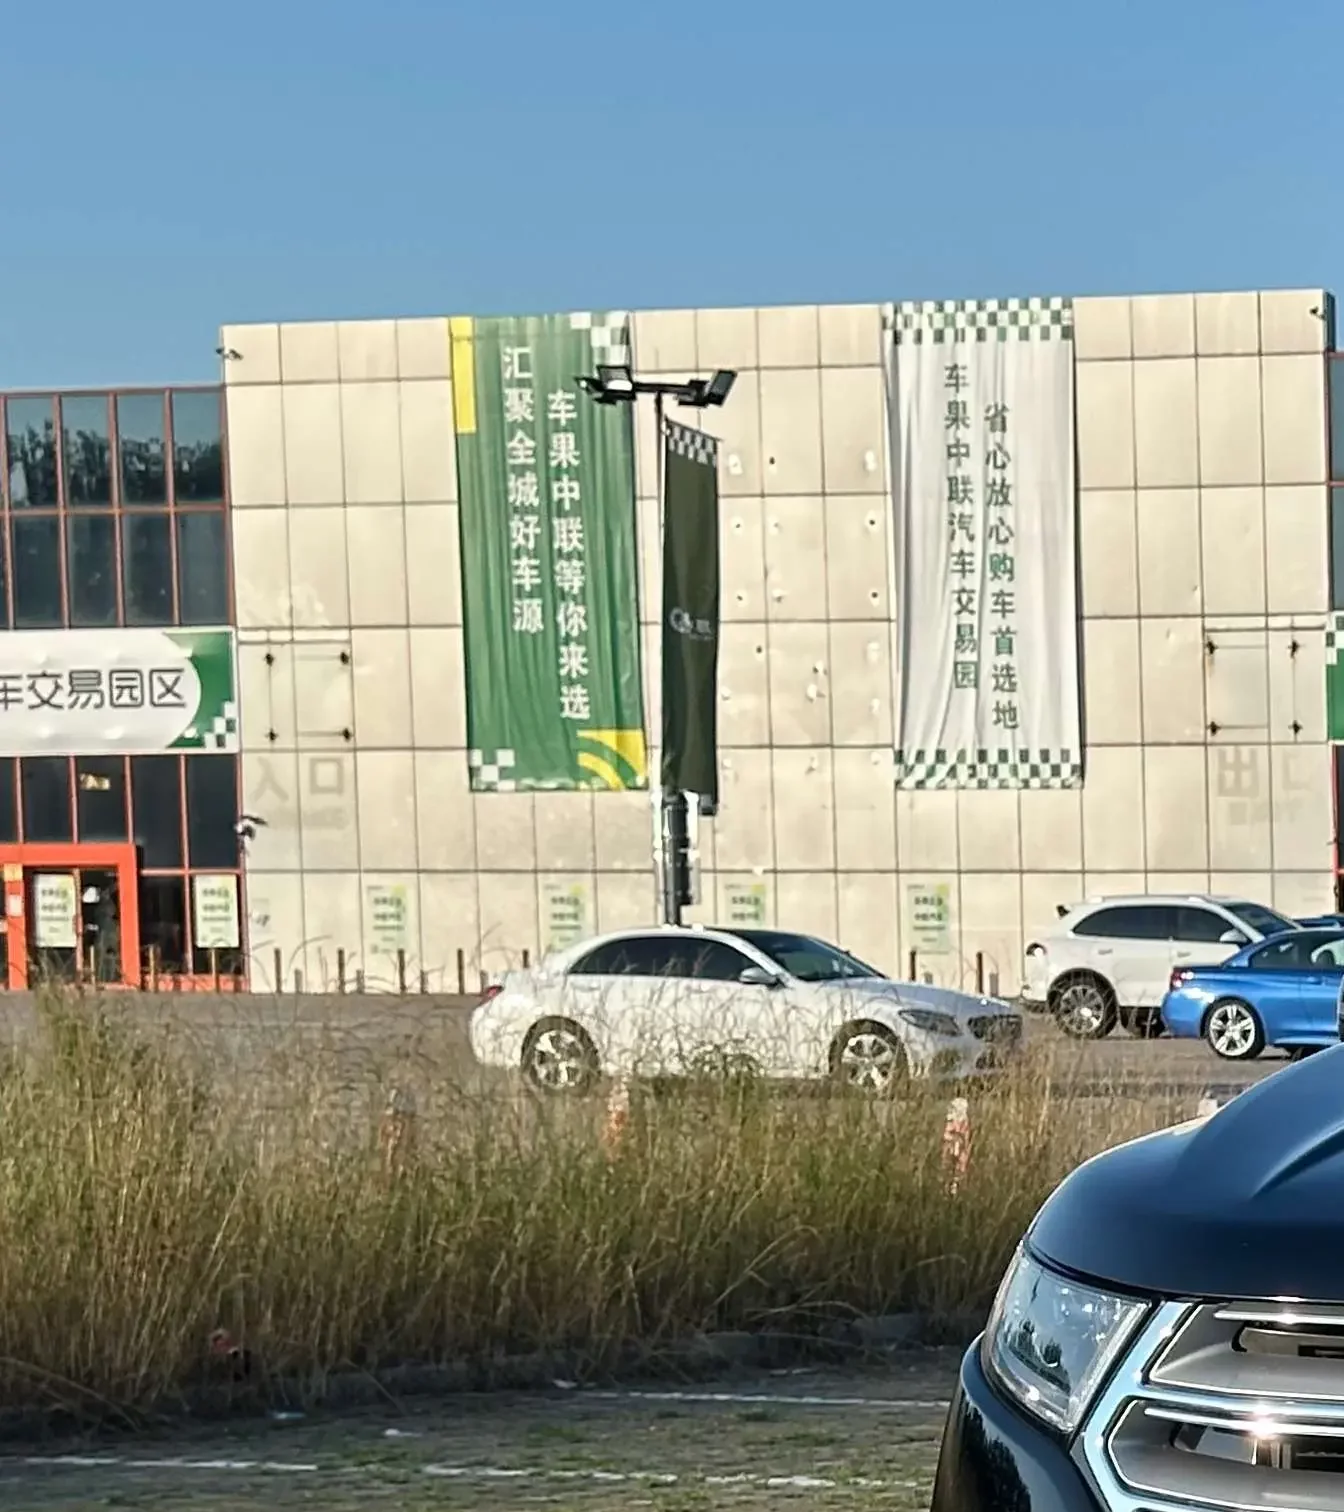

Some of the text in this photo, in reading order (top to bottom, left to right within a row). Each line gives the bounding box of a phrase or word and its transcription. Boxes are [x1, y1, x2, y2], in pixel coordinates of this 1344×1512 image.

[503, 347, 544, 634] 汇聚全城好车源
[547, 389, 591, 720] 车果中联等你来选
[944, 363, 979, 690] 车果中联汽车交易园
[983, 403, 1020, 731] 省心放心购车首选地
